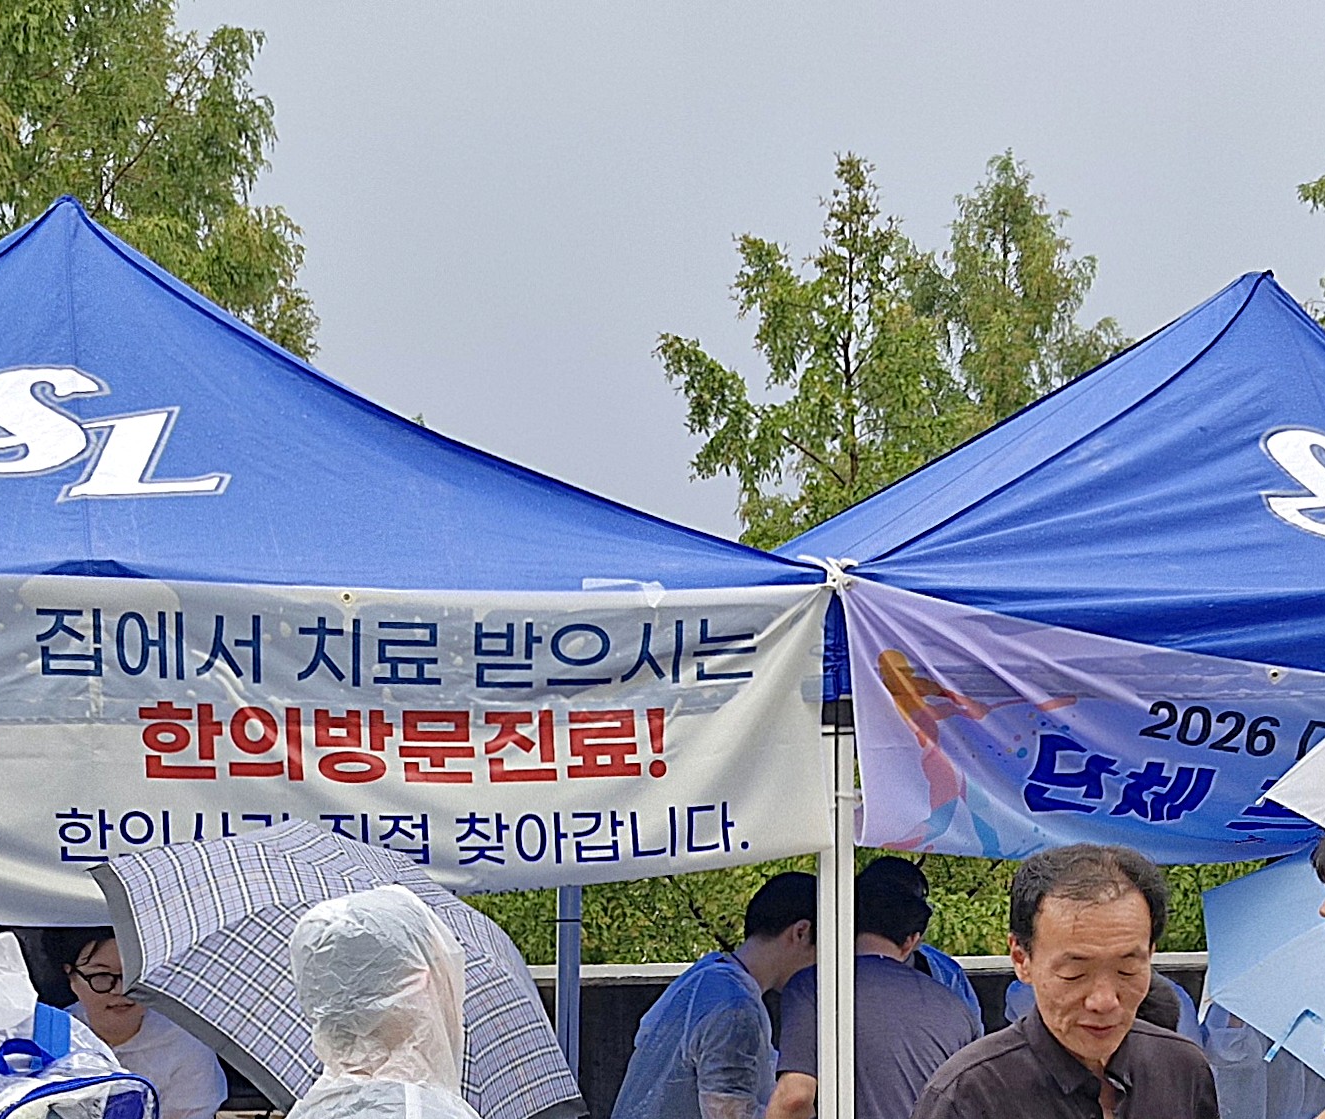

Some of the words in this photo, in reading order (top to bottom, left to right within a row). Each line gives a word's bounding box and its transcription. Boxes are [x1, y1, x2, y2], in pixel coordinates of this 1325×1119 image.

[35, 607, 262, 685] 집에서
[297, 616, 443, 688] 치료
[474, 618, 758, 688] 받으시는
[137, 699, 670, 784] 한의방문진료!
[1138, 700, 1281, 757] 2026
[1023, 732, 1217, 823] 단체
[455, 802, 751, 867] 찾아갑니다.
